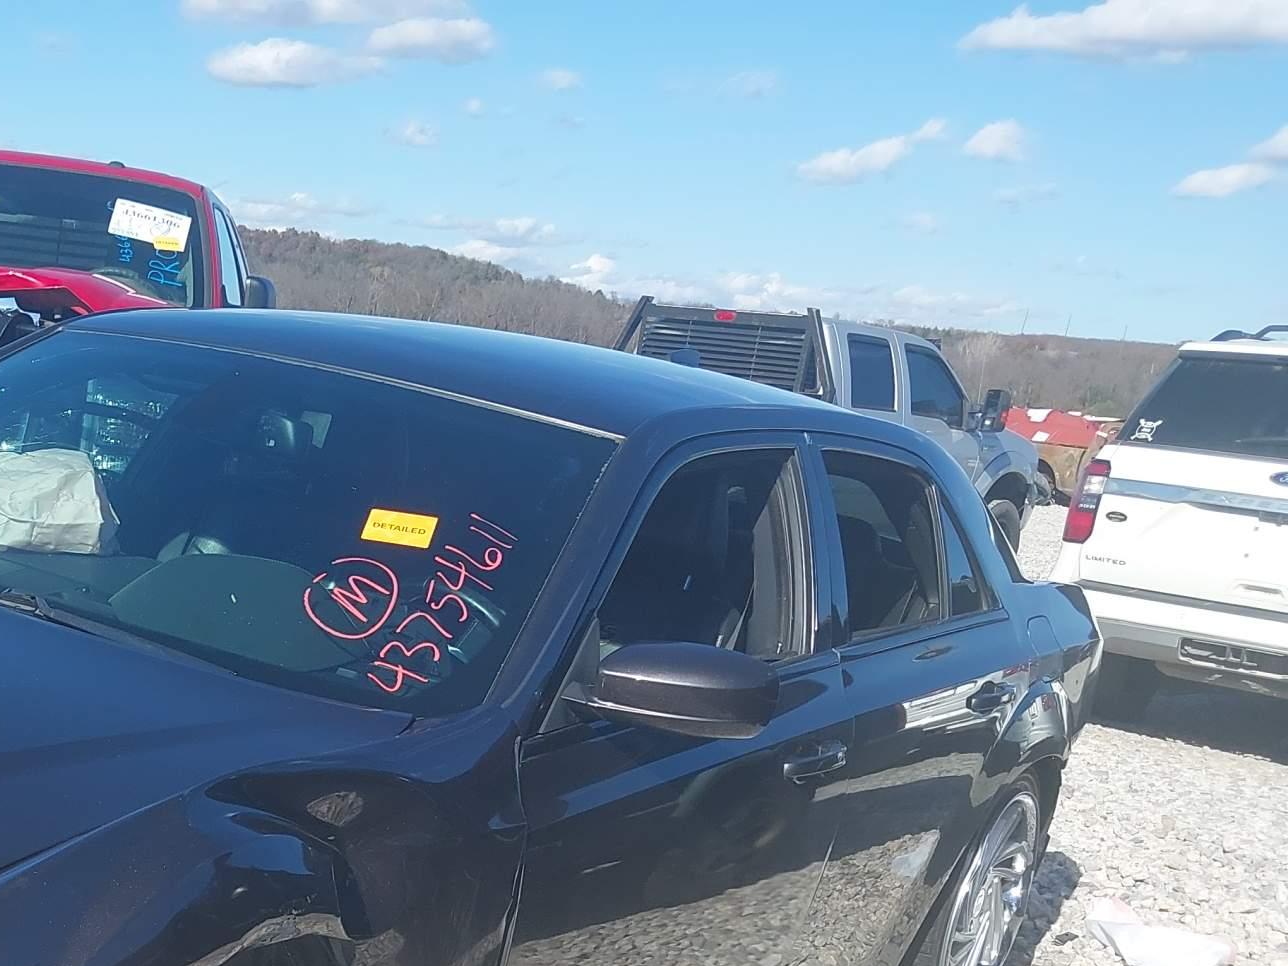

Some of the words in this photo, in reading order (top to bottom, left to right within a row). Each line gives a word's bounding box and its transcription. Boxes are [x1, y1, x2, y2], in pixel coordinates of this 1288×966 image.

[371, 521, 427, 536] DETAILED
[1084, 554, 1127, 567] LIMITED
[367, 512, 520, 692] 43754611
